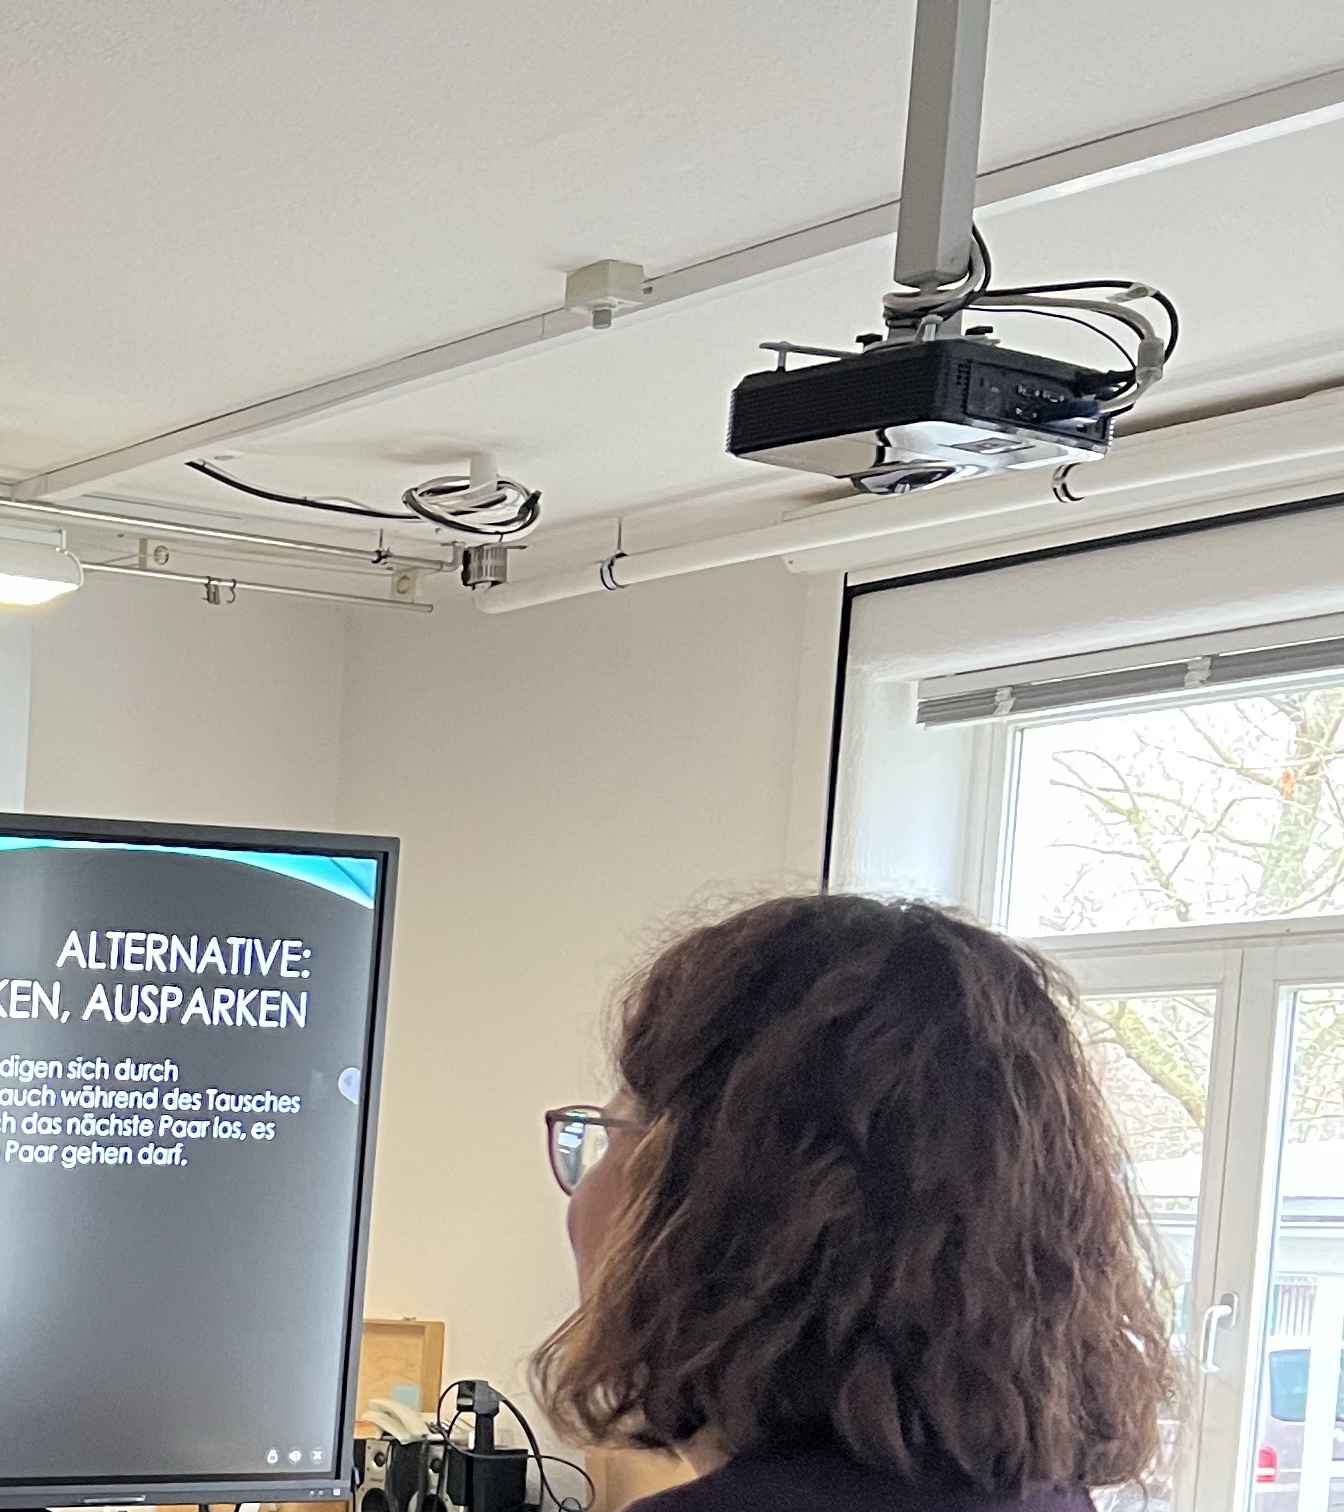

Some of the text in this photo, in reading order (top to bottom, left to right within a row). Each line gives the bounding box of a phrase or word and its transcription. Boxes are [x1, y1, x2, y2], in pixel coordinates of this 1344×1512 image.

[56, 930, 312, 979] ALTERNATIVE:
[82, 984, 308, 1028] AUSPARKEN
[66, 1056, 109, 1080] sich
[114, 1057, 179, 1082] durch
[61, 1086, 159, 1110] während
[163, 1088, 202, 1111] des
[206, 1088, 302, 1114] Tausches
[21, 1112, 62, 1135] das
[66, 1113, 154, 1137] nächste
[159, 1115, 210, 1139] Paar
[213, 1116, 247, 1141] los,
[251, 1120, 276, 1140] es
[5, 1140, 59, 1164] Paar
[62, 1141, 133, 1168] gehen
[138, 1142, 188, 1167] darf.
